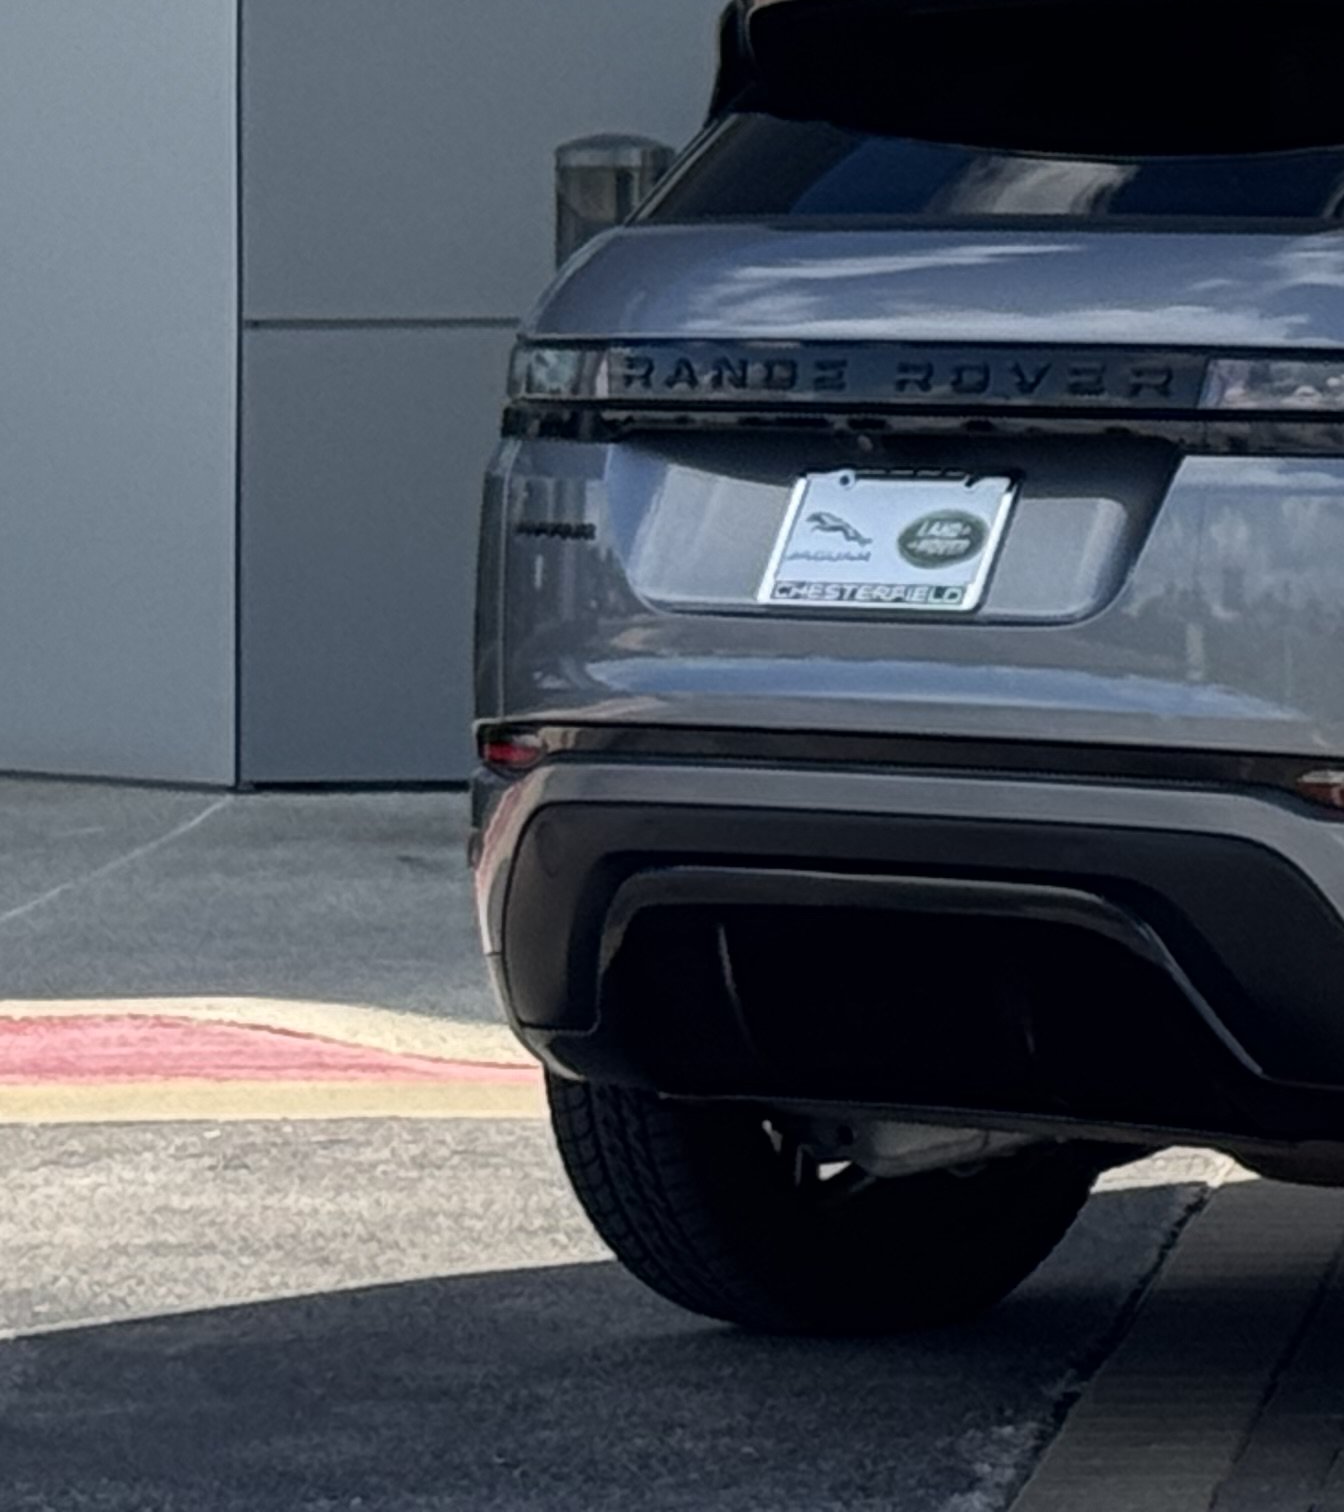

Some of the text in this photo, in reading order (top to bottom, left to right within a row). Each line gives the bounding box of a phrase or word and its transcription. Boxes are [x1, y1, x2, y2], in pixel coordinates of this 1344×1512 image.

[622, 355, 1174, 398] RANGE ROVER
[773, 583, 963, 604] CHESTERFIELD
